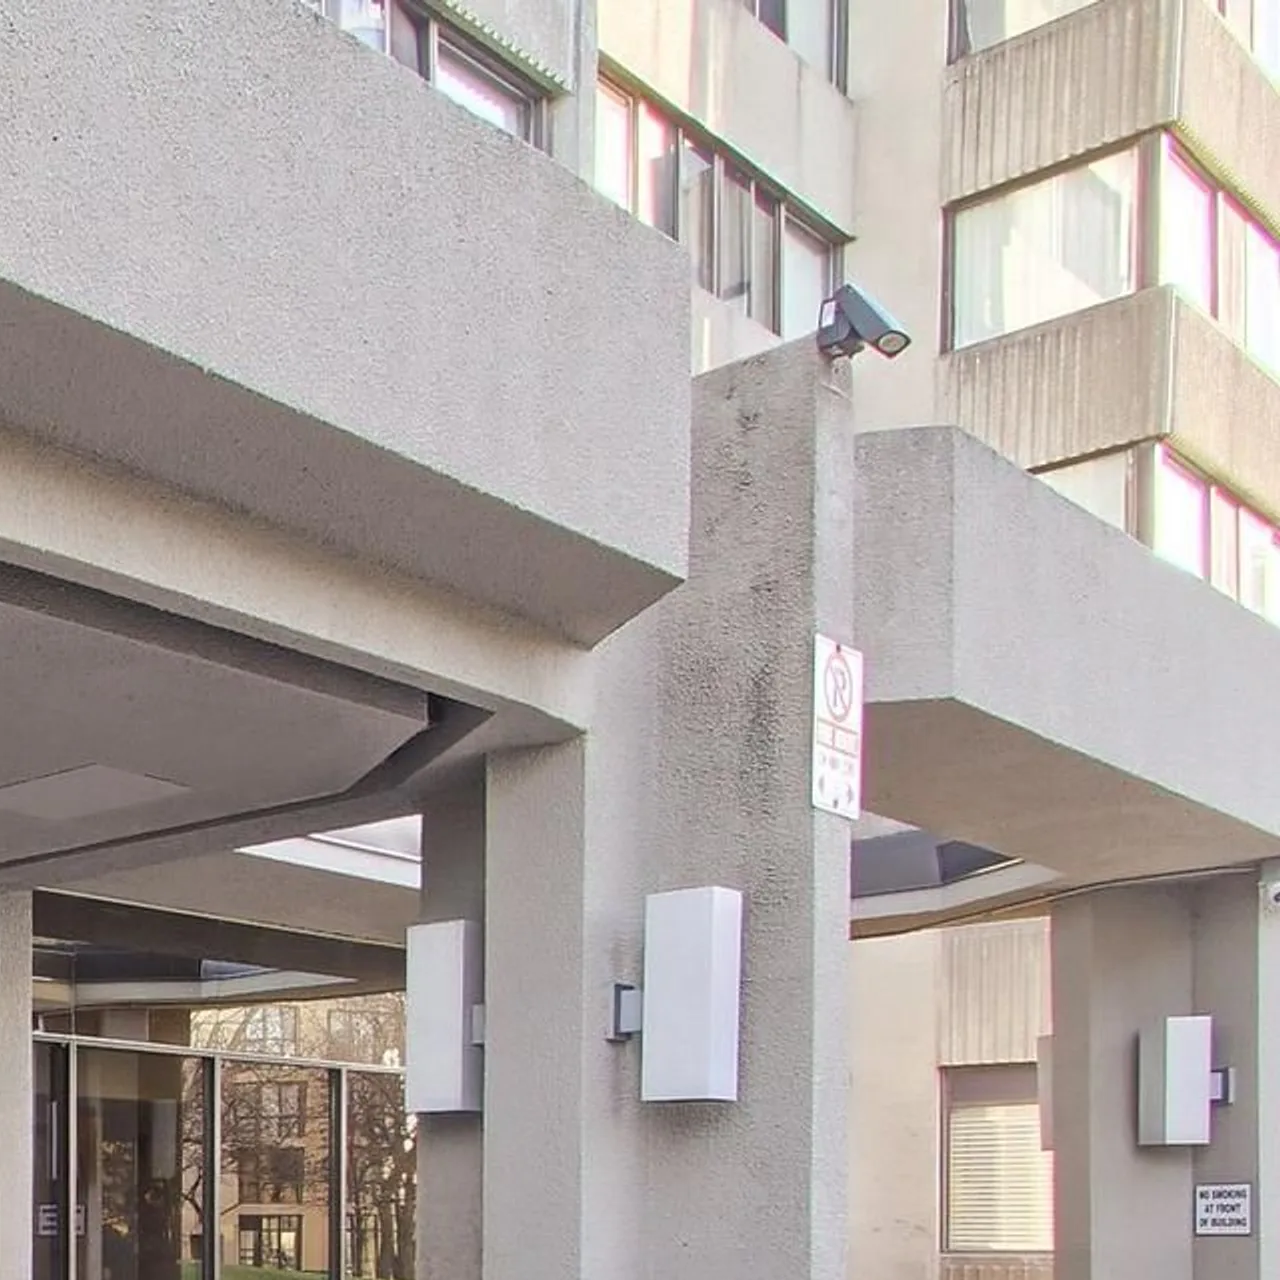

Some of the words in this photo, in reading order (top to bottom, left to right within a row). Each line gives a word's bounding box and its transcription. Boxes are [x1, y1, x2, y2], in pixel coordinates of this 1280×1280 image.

[1200, 1190, 1209, 1199] NO
[1212, 1190, 1247, 1200] SMOKING
[1204, 1204, 1213, 1213] AT
[1216, 1203, 1241, 1213] FRONT
